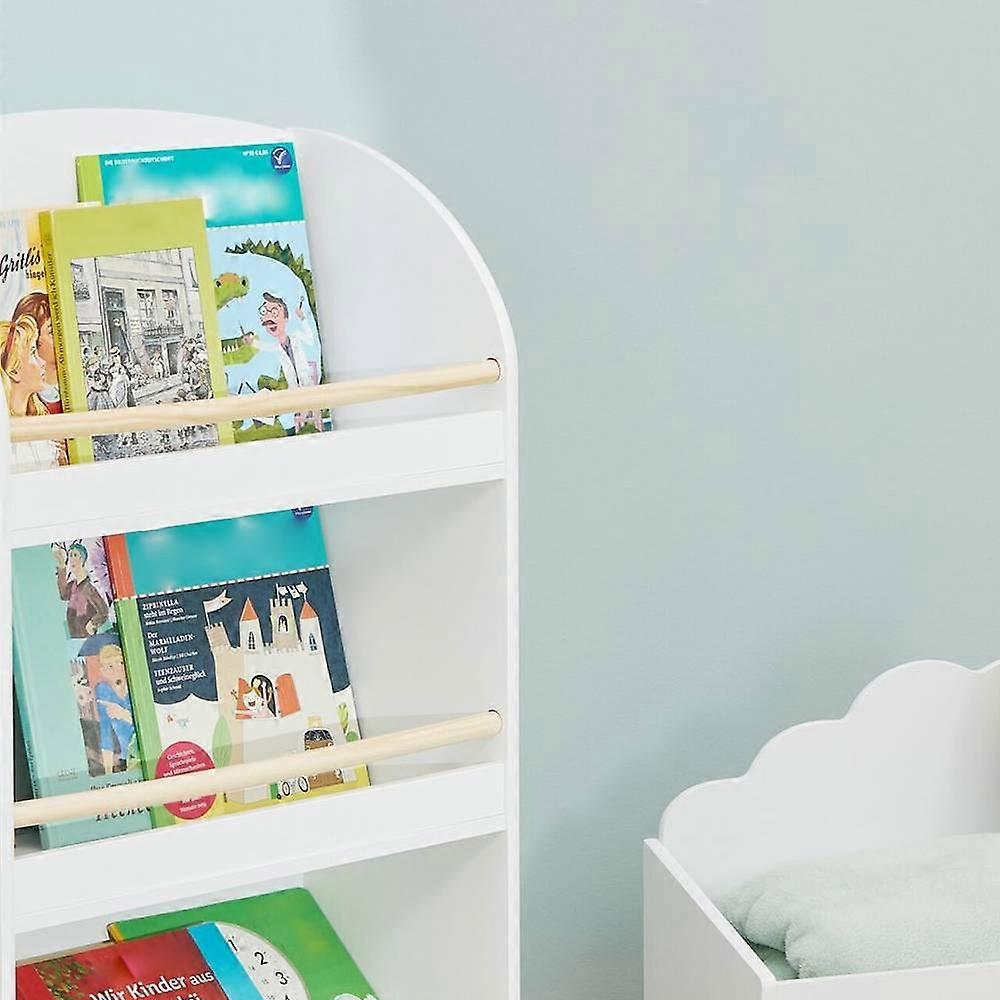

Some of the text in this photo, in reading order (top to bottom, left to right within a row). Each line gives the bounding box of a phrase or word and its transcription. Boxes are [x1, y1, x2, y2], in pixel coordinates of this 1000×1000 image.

[254, 951, 269, 966] 2
[126, 975, 187, 1000] Kinder
[189, 971, 215, 986] aus
[275, 971, 288, 986] 3
